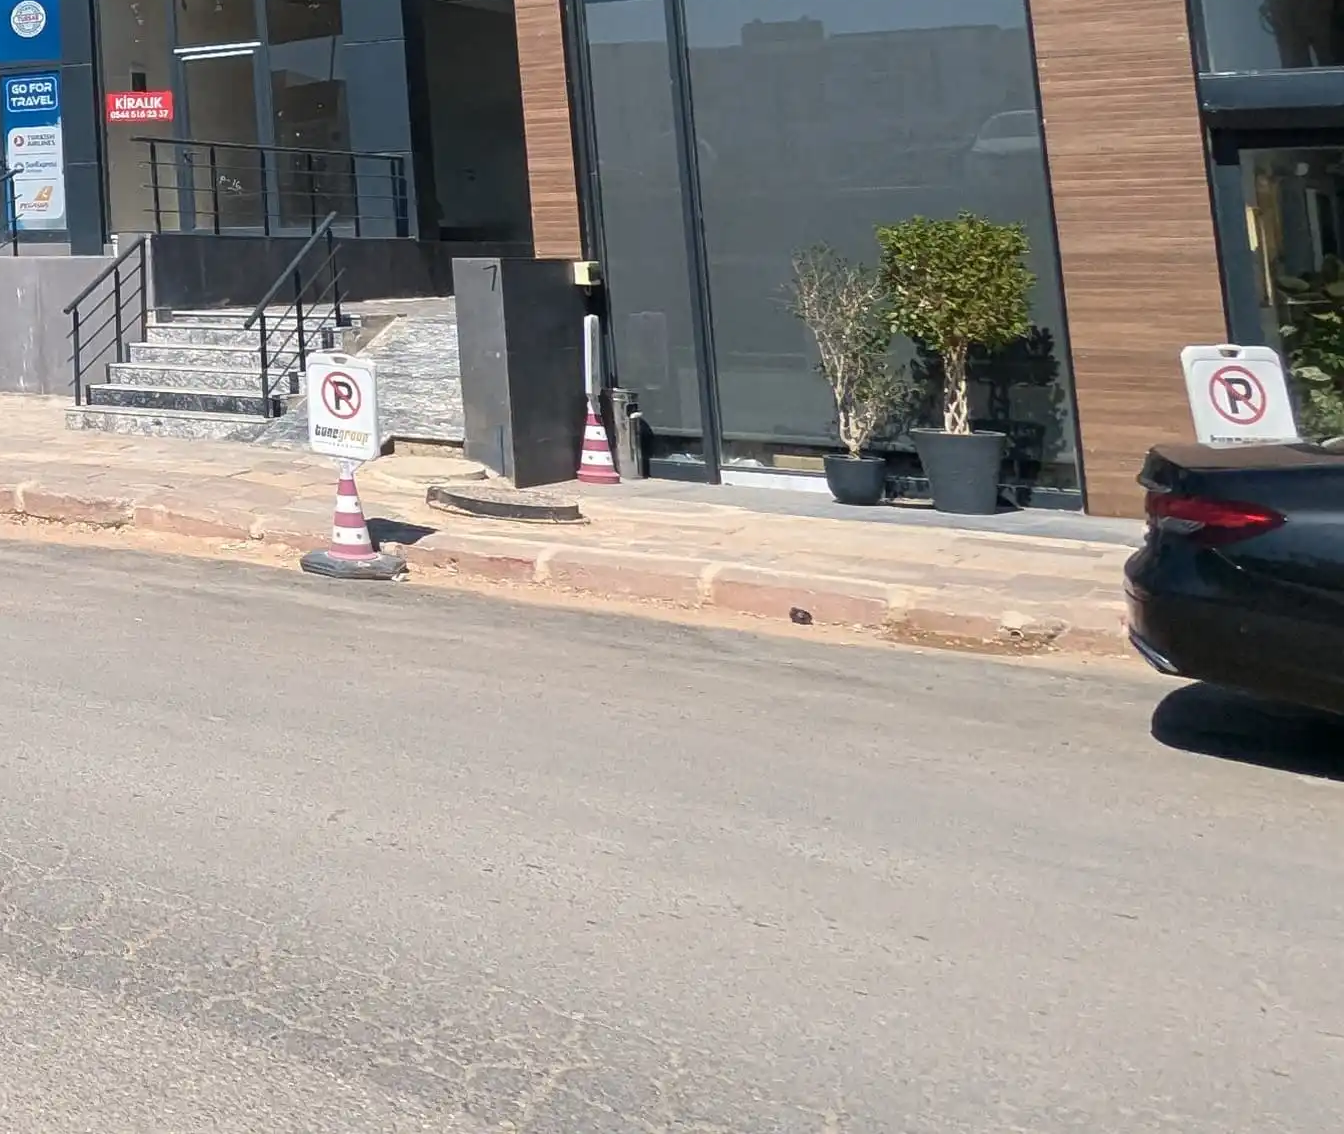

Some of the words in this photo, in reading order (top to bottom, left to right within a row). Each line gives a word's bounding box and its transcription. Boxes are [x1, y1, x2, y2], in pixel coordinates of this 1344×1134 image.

[11, 84, 28, 95] GO
[29, 82, 53, 93] FOR
[10, 95, 54, 107] TRAVEL
